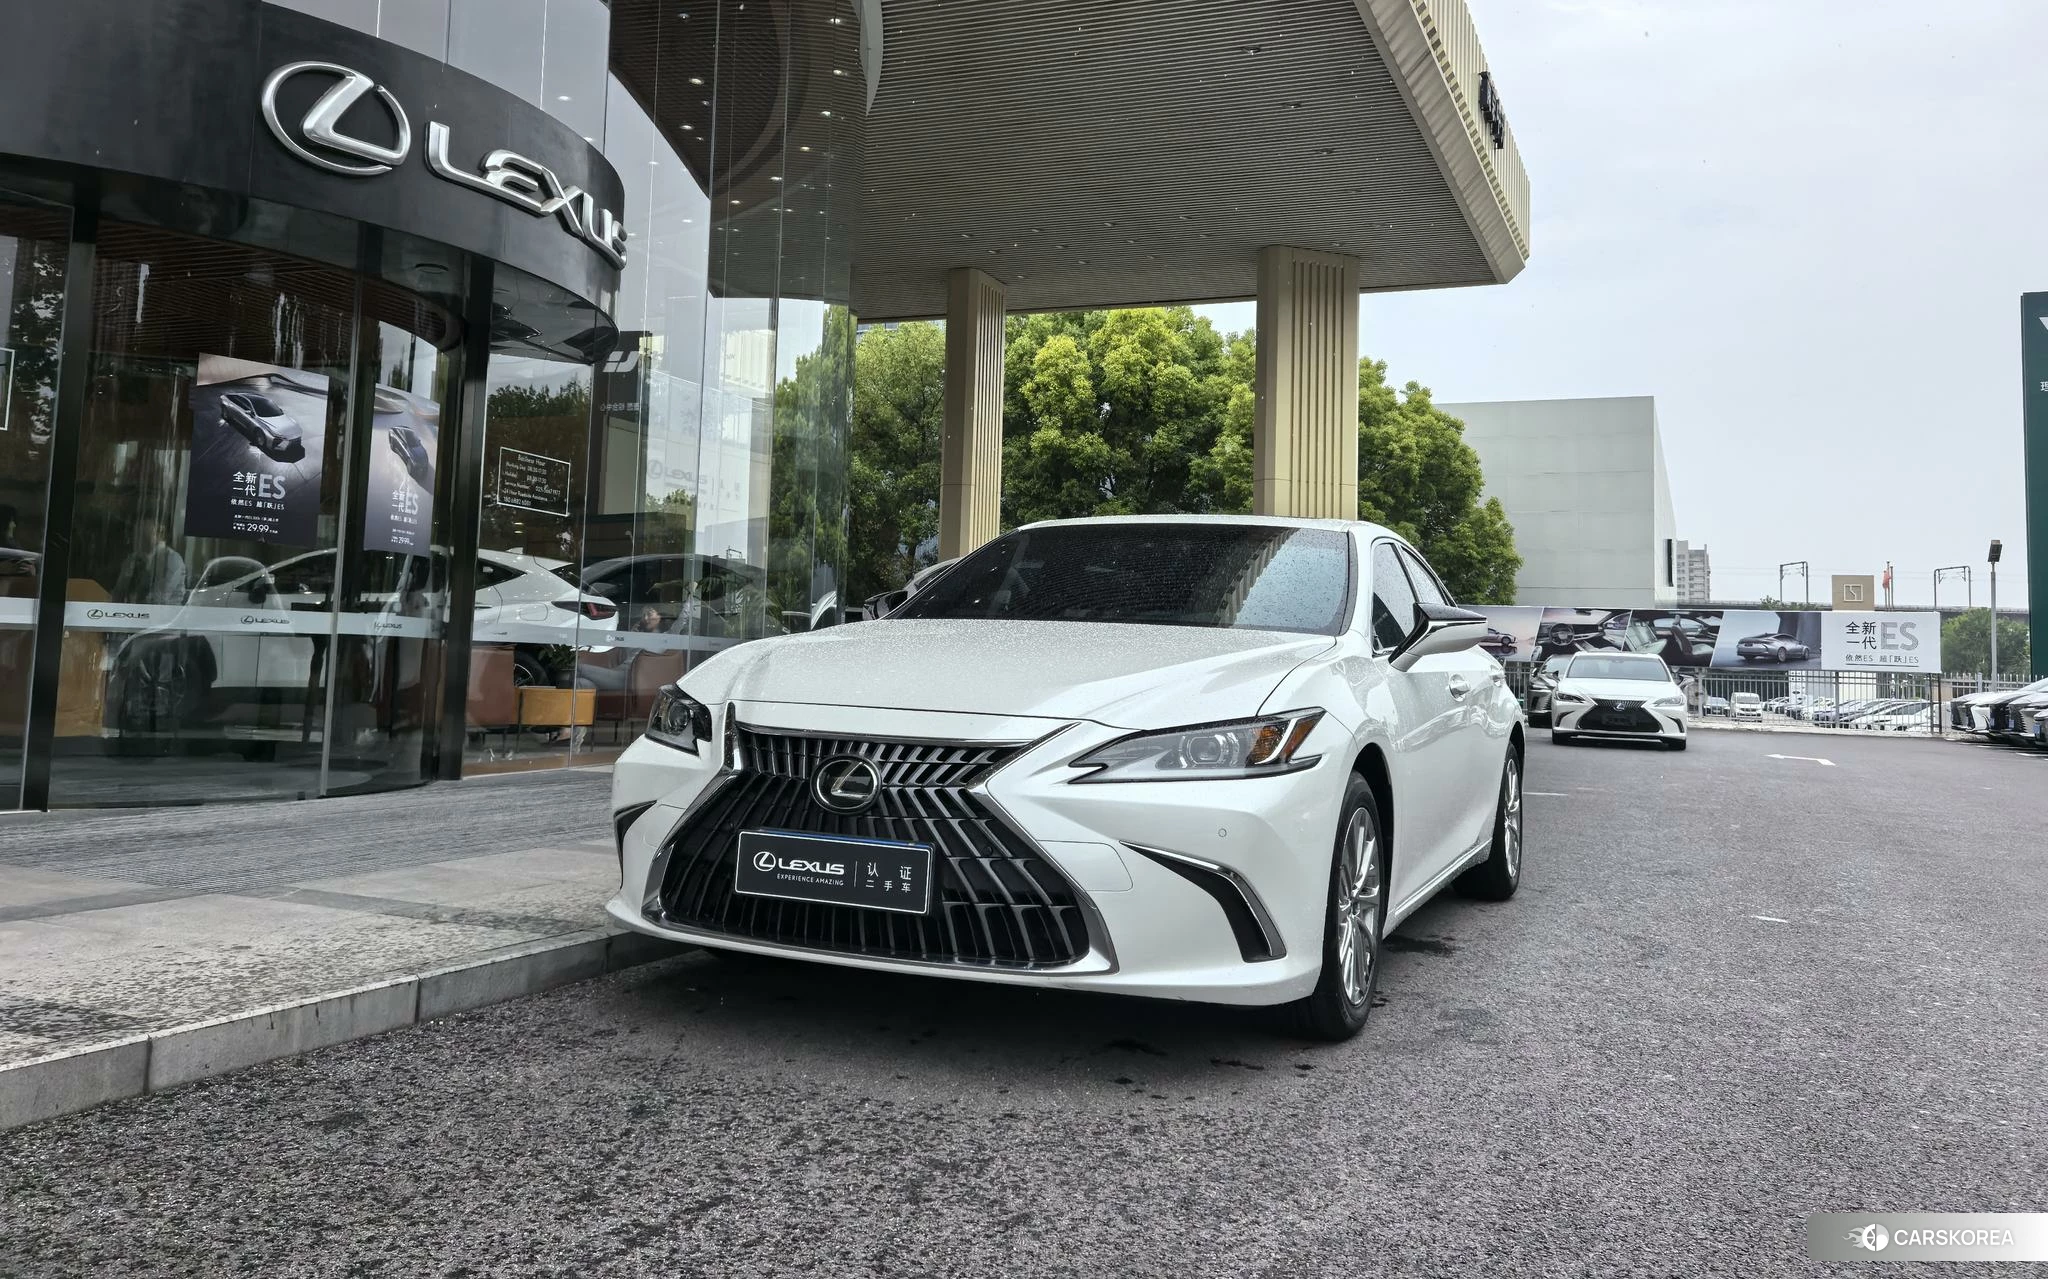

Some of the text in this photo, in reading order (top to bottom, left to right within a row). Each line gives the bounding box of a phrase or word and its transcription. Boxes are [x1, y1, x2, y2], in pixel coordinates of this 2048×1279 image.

[425, 121, 628, 271] LEXUS
[233, 471, 257, 484] 全新
[233, 484, 256, 496] 一代
[258, 473, 286, 500] ES
[405, 490, 419, 515] ES
[247, 523, 269, 533] 29.99
[104, 611, 150, 619] LEXUS
[254, 617, 290, 625] LEXUS
[1845, 621, 1877, 635] 全新
[1846, 636, 1877, 650] 一代
[1880, 621, 1919, 651] ES
[778, 857, 845, 876] LEXUS
[867, 862, 912, 881] 认证
[776, 873, 844, 886] EXPERIENCE AMAZING
[865, 879, 912, 893] 二手车
